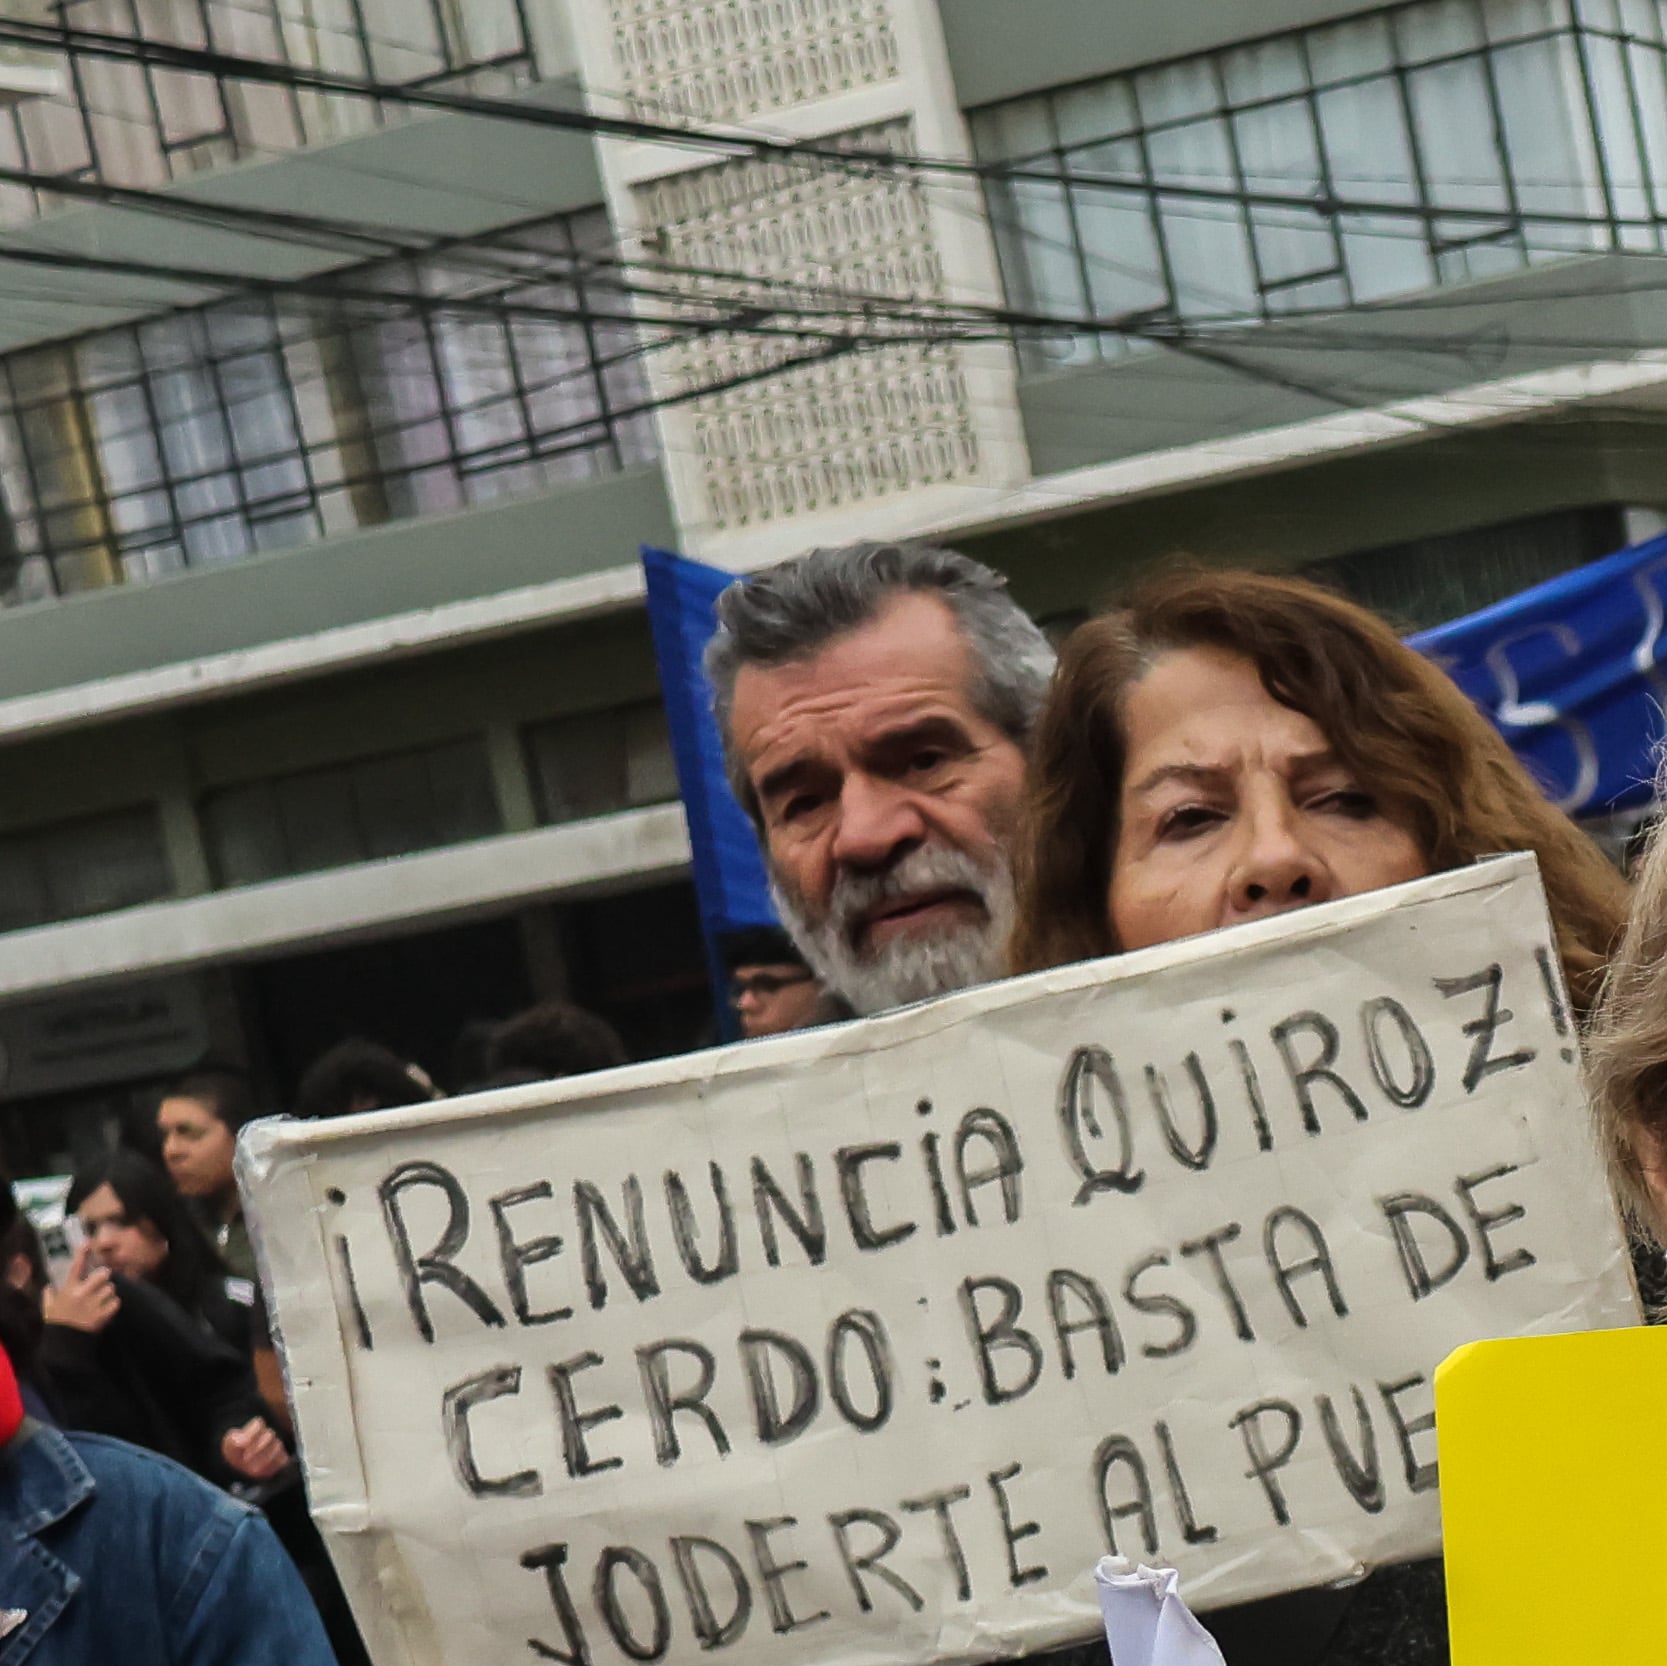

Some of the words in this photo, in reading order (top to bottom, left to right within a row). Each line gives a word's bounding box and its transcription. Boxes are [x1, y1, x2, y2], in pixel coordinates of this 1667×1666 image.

[957, 1222, 1349, 1405] BASTA
[1383, 1163, 1537, 1302] DE
[1095, 1420, 1217, 1557] AL
